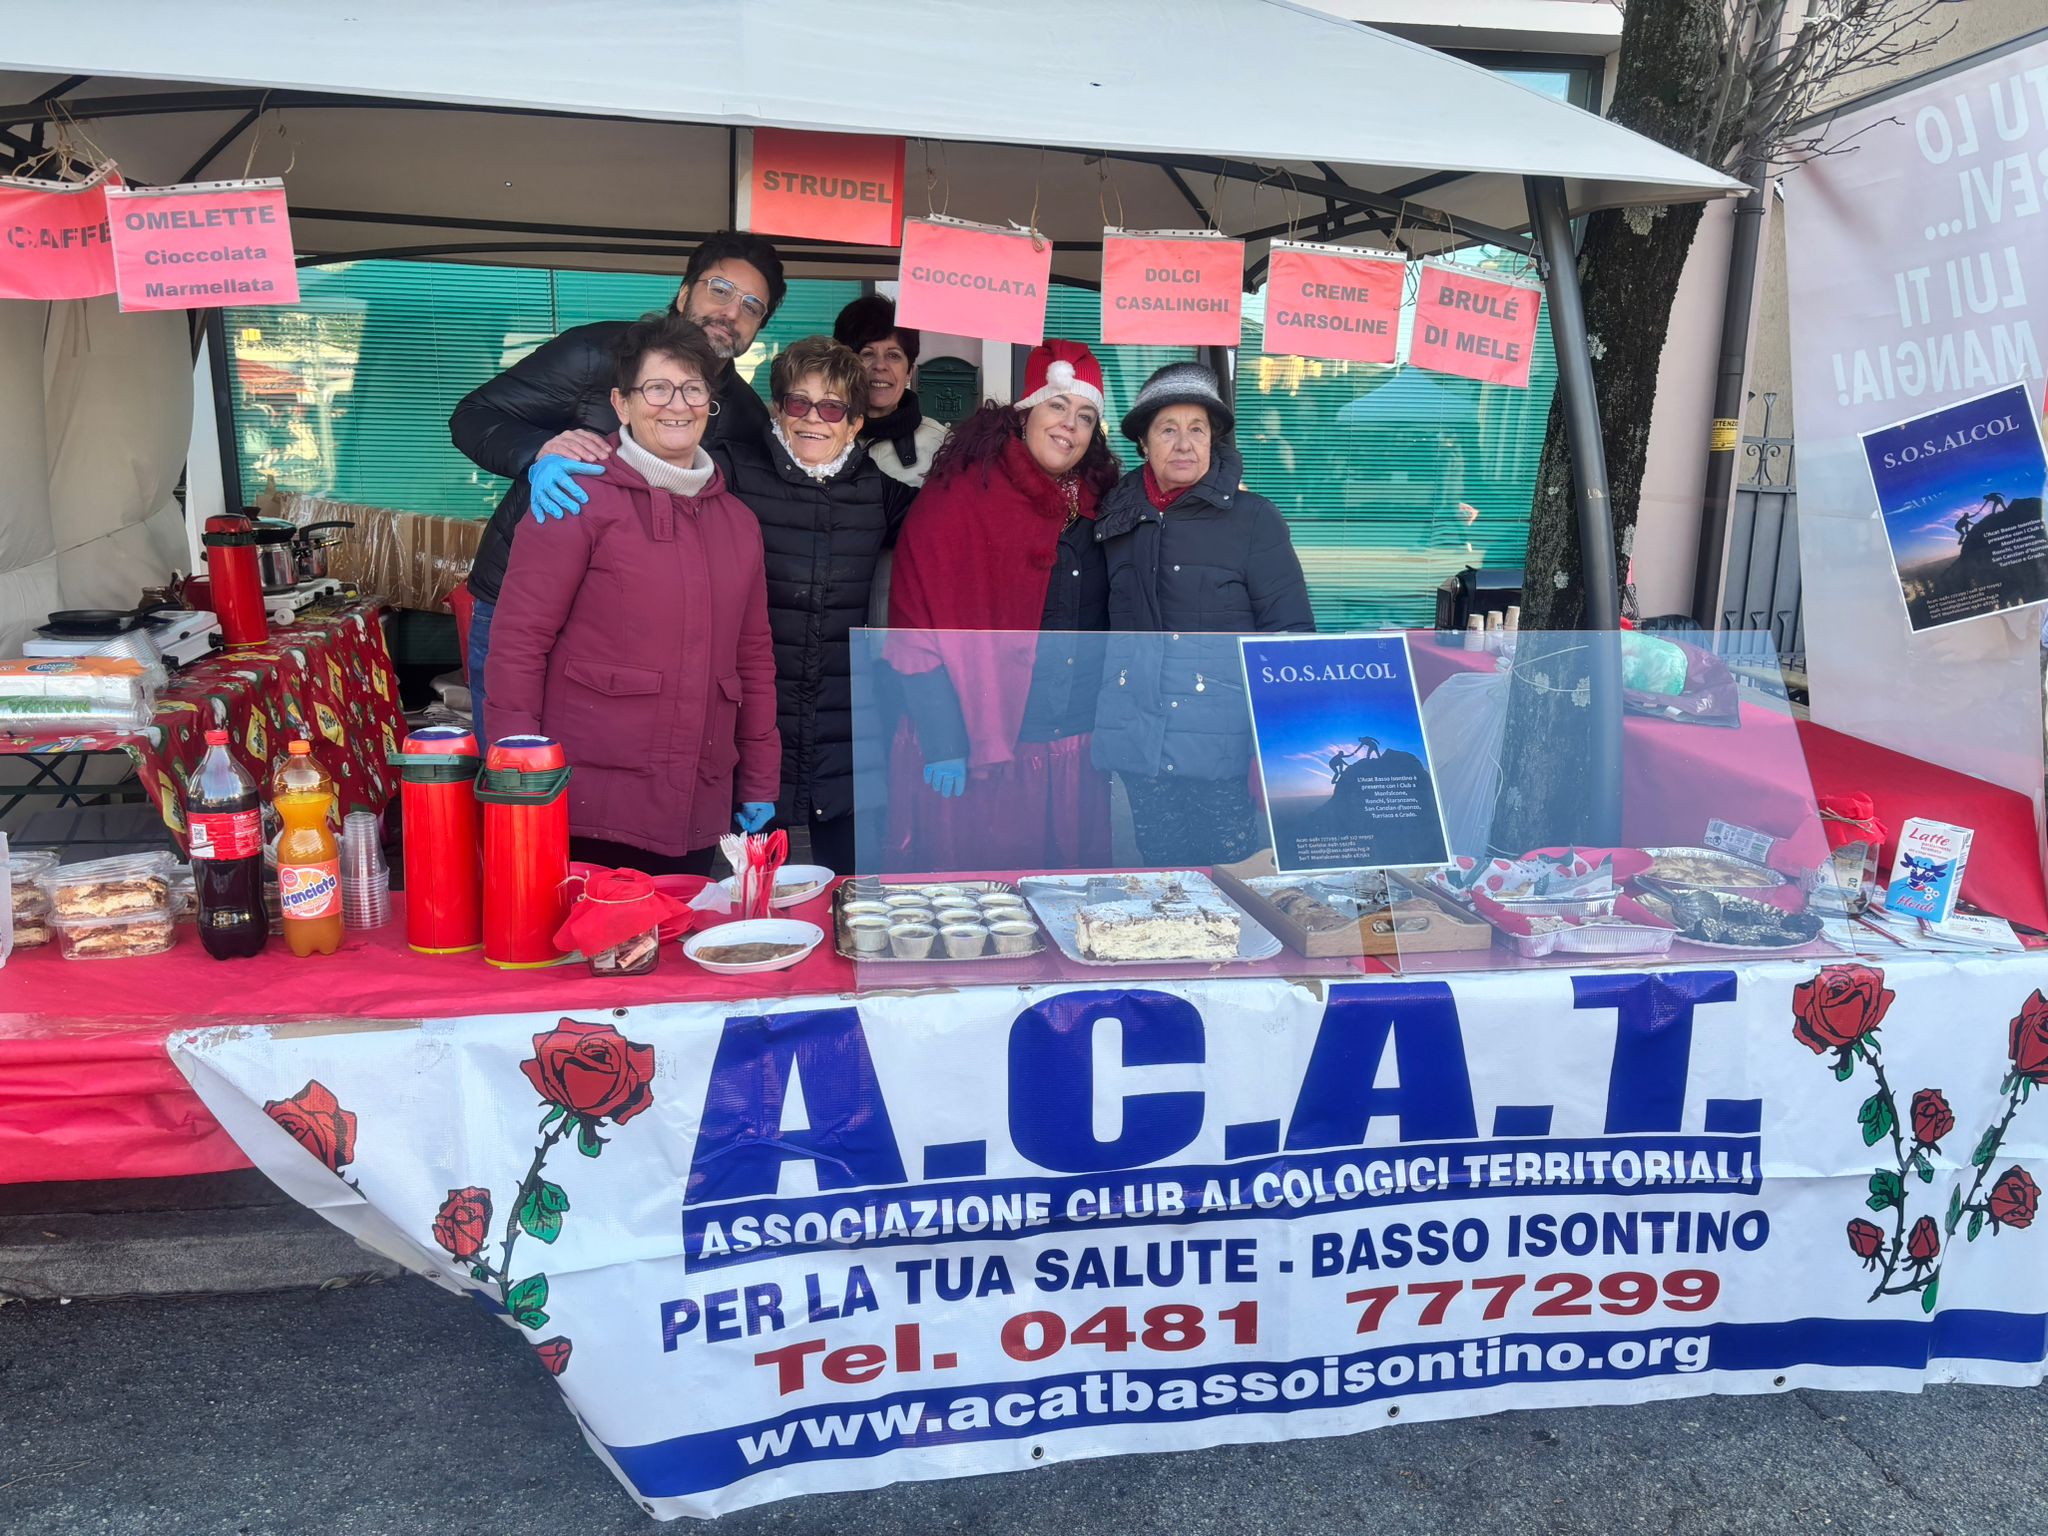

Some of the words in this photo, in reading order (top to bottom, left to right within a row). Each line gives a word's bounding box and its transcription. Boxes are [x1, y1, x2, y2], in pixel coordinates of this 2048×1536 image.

[762, 169, 893, 204] STRUDEL
[125, 205, 276, 231] OMELETTE
[144, 246, 267, 266] Cioccolata
[145, 279, 274, 298] Marmellata
[911, 266, 1037, 299] CIOCCOLATA
[1145, 268, 1201, 284] DOLCI
[1115, 296, 1230, 314] CASALINGHI
[1301, 282, 1370, 304] CREME
[1438, 286, 1519, 321] BRULÉ
[1276, 310, 1389, 336] CARSOLINE
[1424, 325, 1450, 348] DI
[1456, 330, 1521, 363] MELE
[1883, 414, 2020, 470] S.O.S.ALCOL
[1261, 662, 1397, 684] S.O.S.ALCOL
[1908, 827, 1951, 847] Latte
[1896, 894, 1936, 913] Heidi
[698, 1192, 1051, 1259] ASSOCIAZIONE
[1065, 1180, 1187, 1222] CLUB
[1198, 1156, 1450, 1214] ALCOLOGICI
[1463, 1149, 1756, 1190] TERRITORIALI
[660, 1282, 786, 1353] PER
[805, 1264, 880, 1322] LA
[895, 1255, 1016, 1304] TUA
[1034, 1238, 1258, 1292] SALUTE
[1312, 1217, 1490, 1278] BASSO
[1507, 1209, 1770, 1260] ISONTINO
[754, 1322, 958, 1397] Tel.
[1000, 1302, 1258, 1362] 0481
[1345, 1268, 1722, 1335] 777299
[737, 1334, 1712, 1466] www.acatbassoisontino.org
